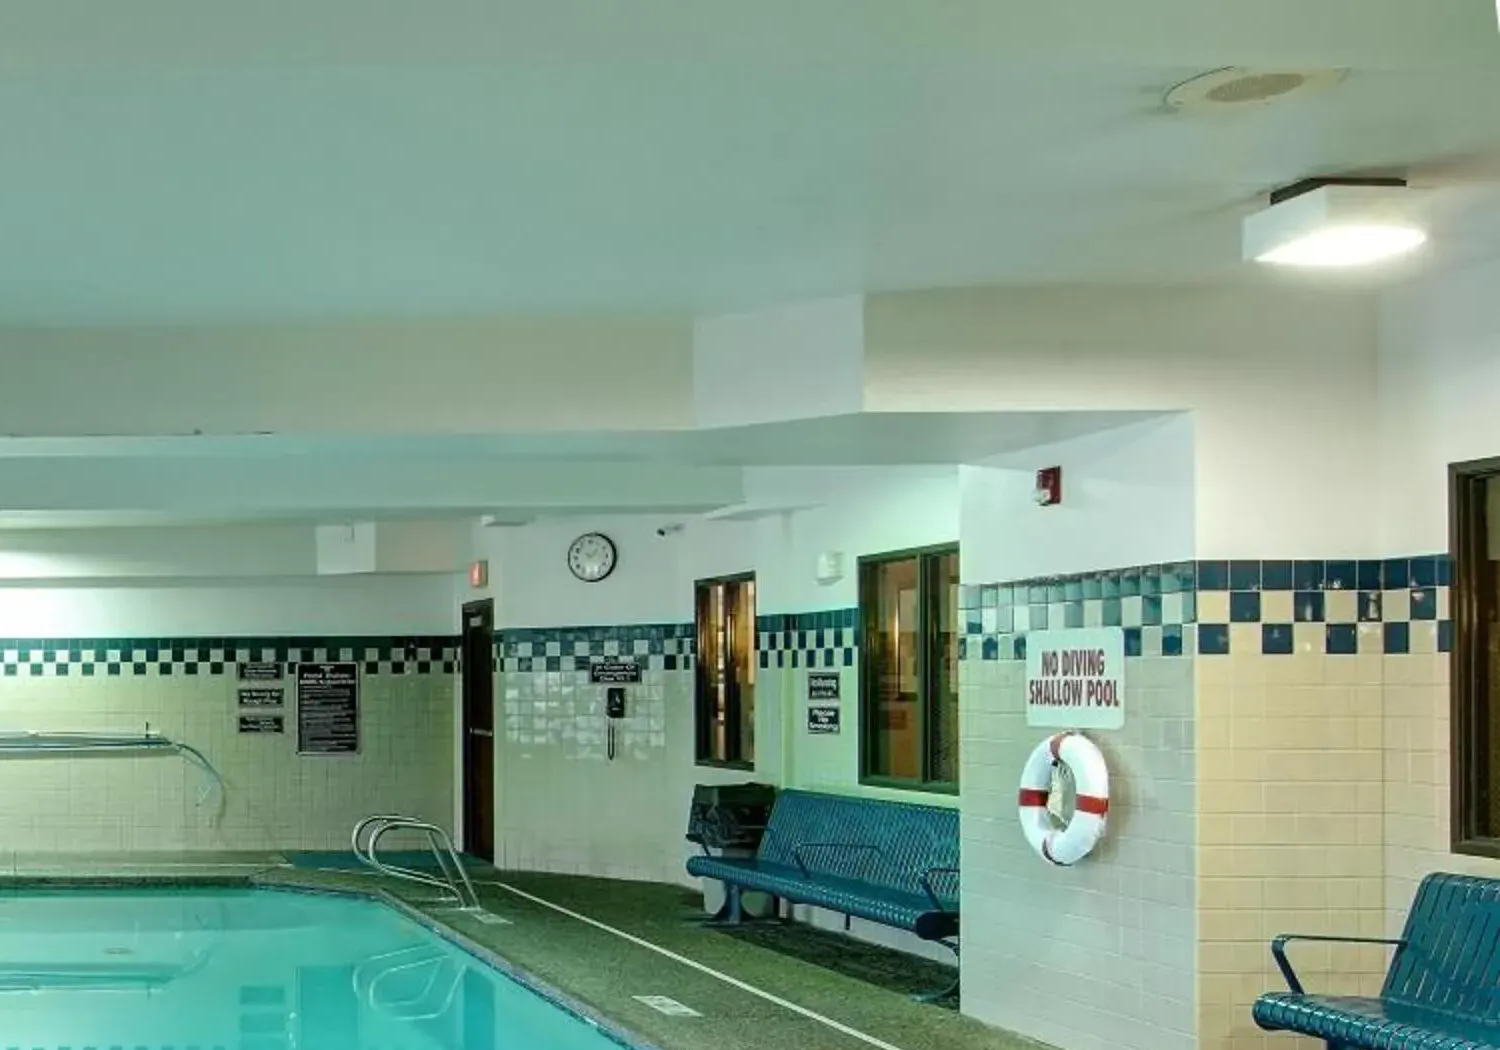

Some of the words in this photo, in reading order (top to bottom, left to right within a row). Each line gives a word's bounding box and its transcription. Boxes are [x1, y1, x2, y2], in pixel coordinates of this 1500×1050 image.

[1041, 651, 1059, 677] NO
[1061, 649, 1105, 677] DIVING
[1029, 679, 1083, 707] SHALLOW
[1086, 679, 1120, 707] POOL
